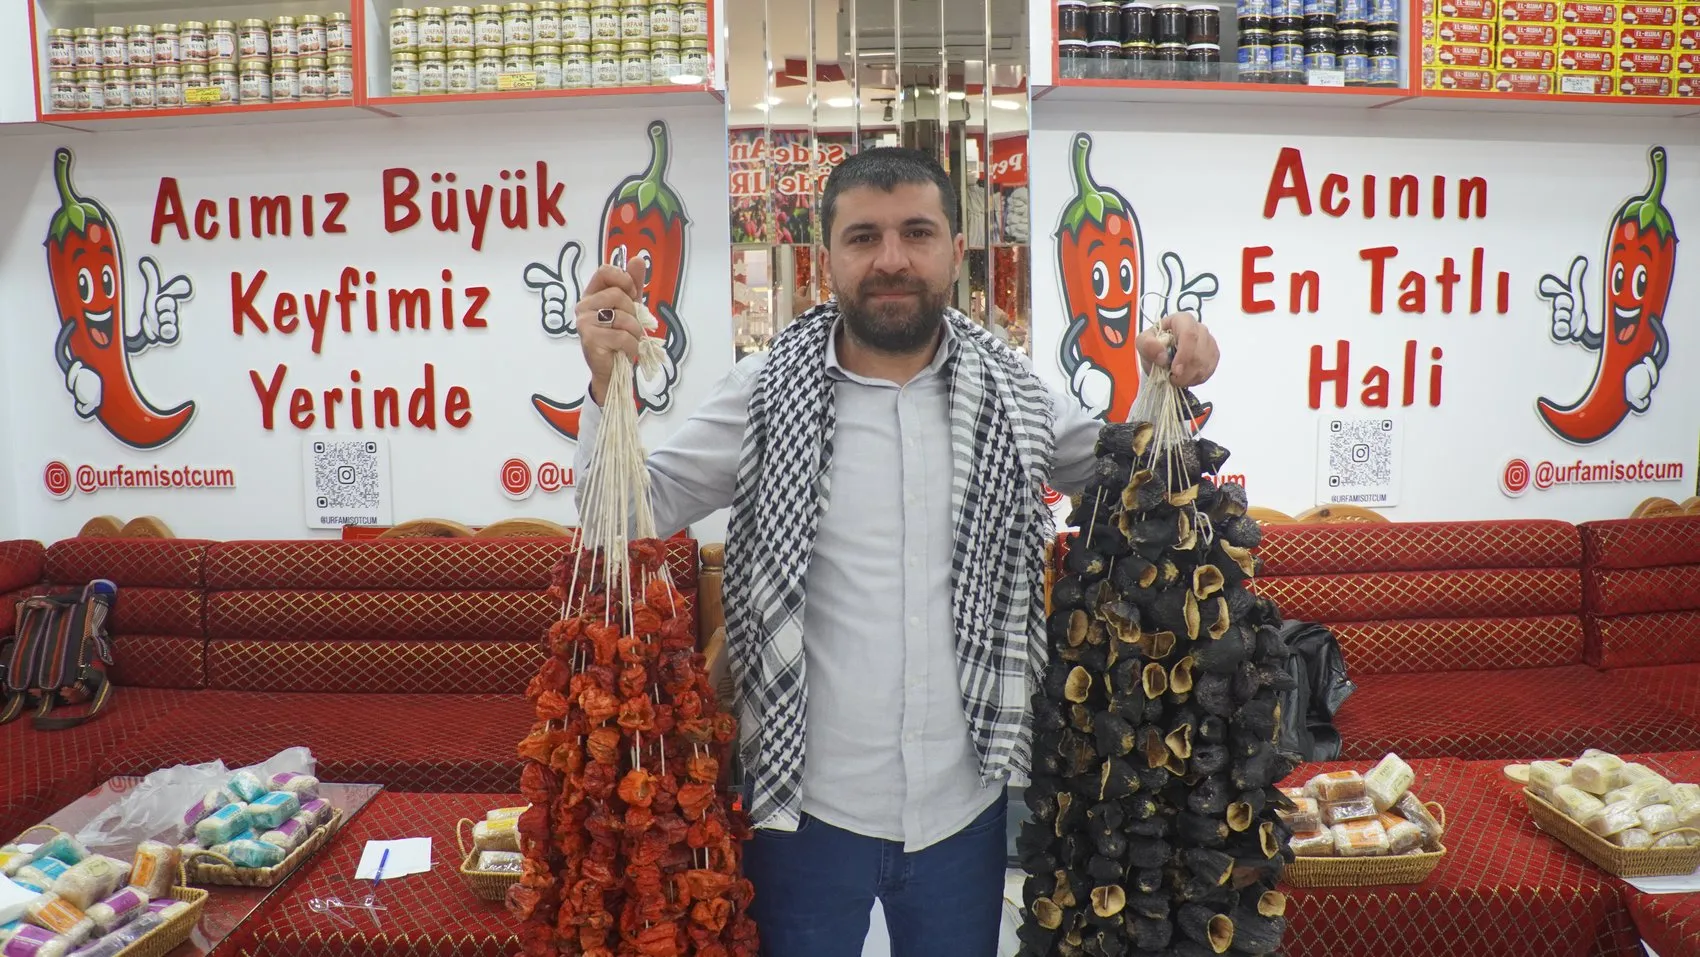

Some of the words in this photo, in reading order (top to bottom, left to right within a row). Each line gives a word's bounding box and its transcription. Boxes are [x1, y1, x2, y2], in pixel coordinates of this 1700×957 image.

[151, 178, 348, 244] Acımız
[384, 161, 565, 250] Büyük
[1264, 147, 1487, 219] Acının
[231, 267, 490, 353] Keyfimiz
[1242, 246, 1320, 314] En
[1359, 246, 1509, 314] Tatlı
[250, 363, 471, 430] Yerinde
[1309, 339, 1443, 409] Hali
[76, 465, 236, 492] @urfamisotcum
[1536, 461, 1684, 489] @urfamisotcum
